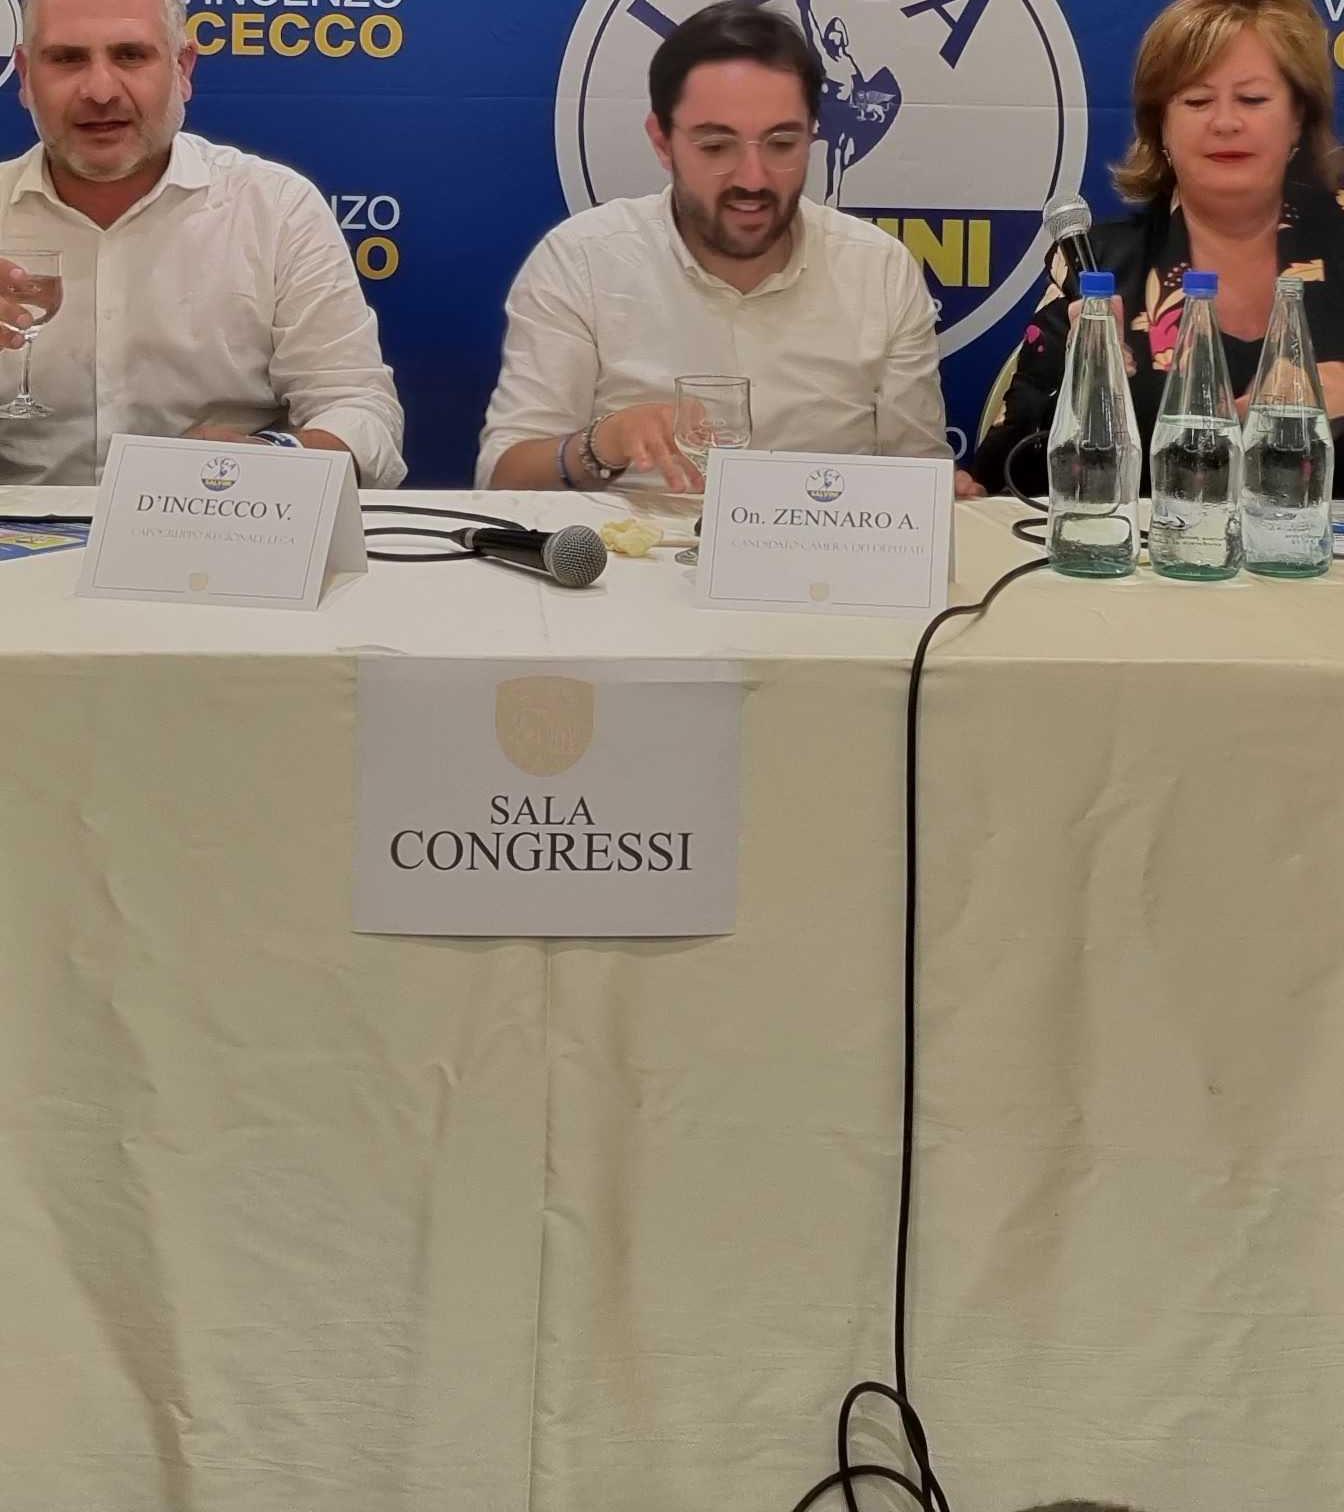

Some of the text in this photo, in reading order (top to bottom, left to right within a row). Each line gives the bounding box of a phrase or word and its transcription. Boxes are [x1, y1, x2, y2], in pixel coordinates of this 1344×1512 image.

[186, 11, 403, 58] CECCO
[136, 494, 292, 520] D'INCECCO V.
[731, 506, 920, 530] On. ZENNARO A.
[490, 795, 596, 827] SALA
[390, 829, 694, 872] CONGRESSI
